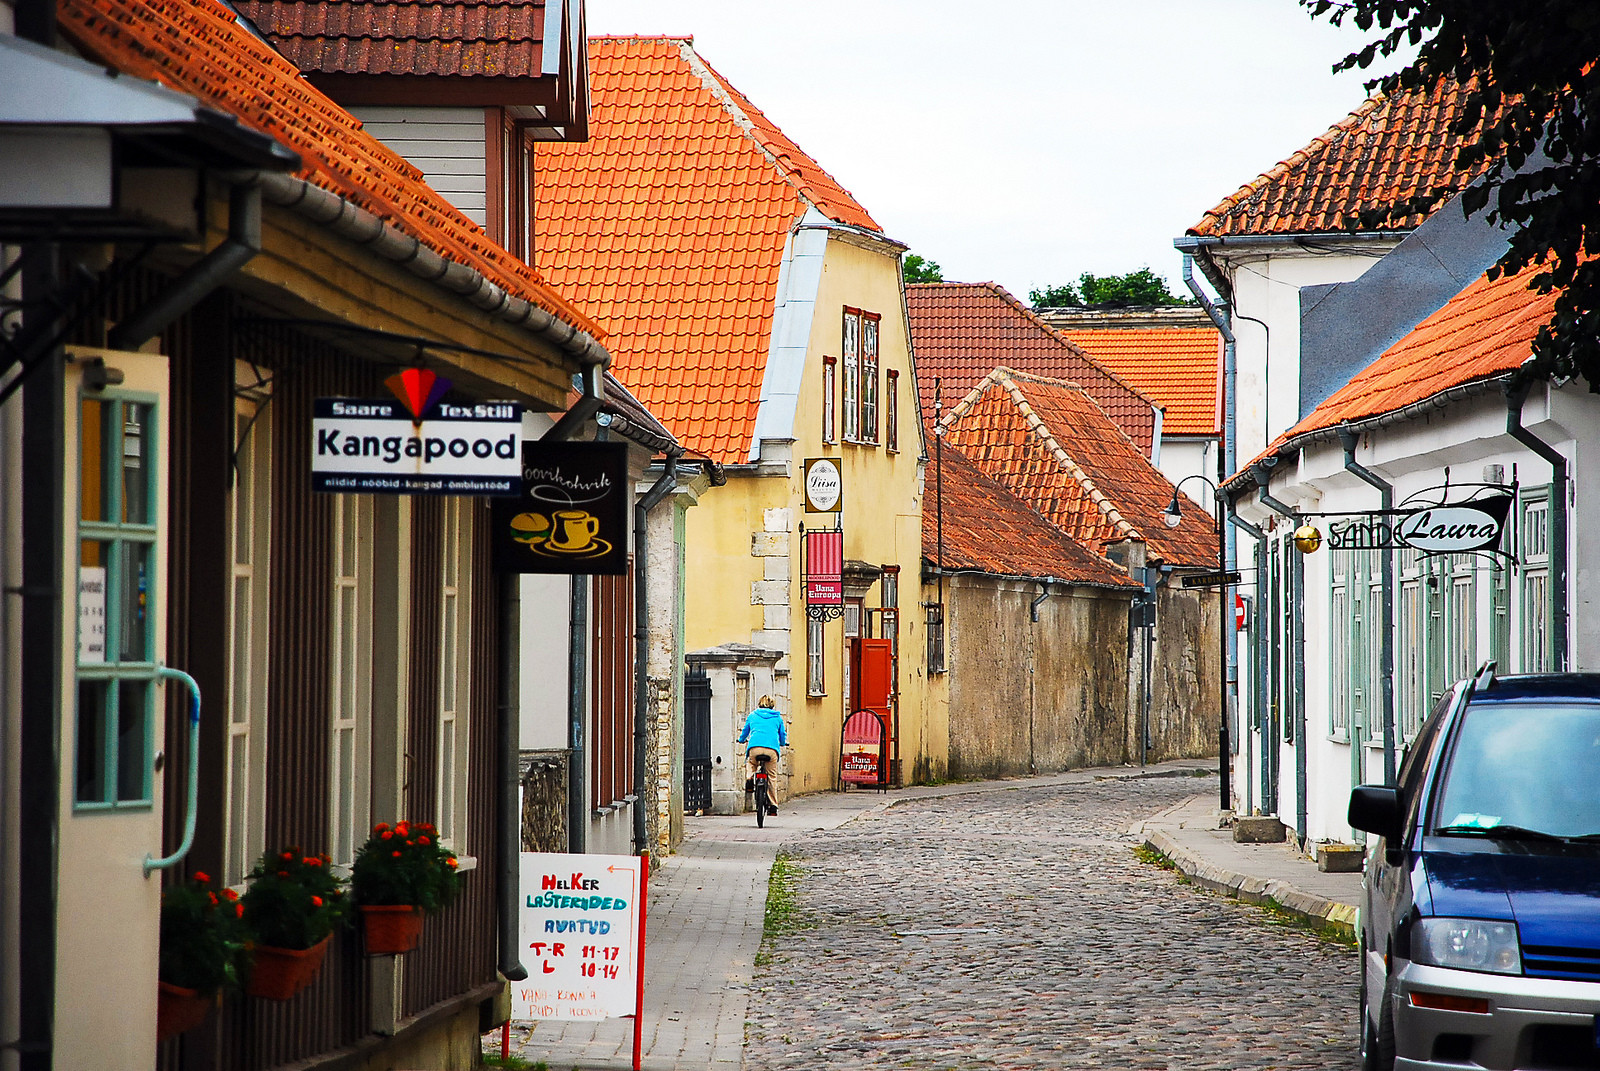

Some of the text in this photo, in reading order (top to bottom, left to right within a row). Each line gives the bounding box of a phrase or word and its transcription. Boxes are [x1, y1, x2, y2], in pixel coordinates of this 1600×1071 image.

[332, 402, 392, 416] Saare
[318, 428, 516, 464] Kangapood
[325, 478, 357, 487] niidid
[810, 475, 837, 488] Liisa
[1403, 510, 1496, 540] Laura
[815, 583, 835, 592] Vana
[808, 590, 841, 600] Euroopa
[851, 755, 871, 764] Vana
[529, 942, 620, 961] T-R 11-17
[542, 959, 619, 980] L 10-14
